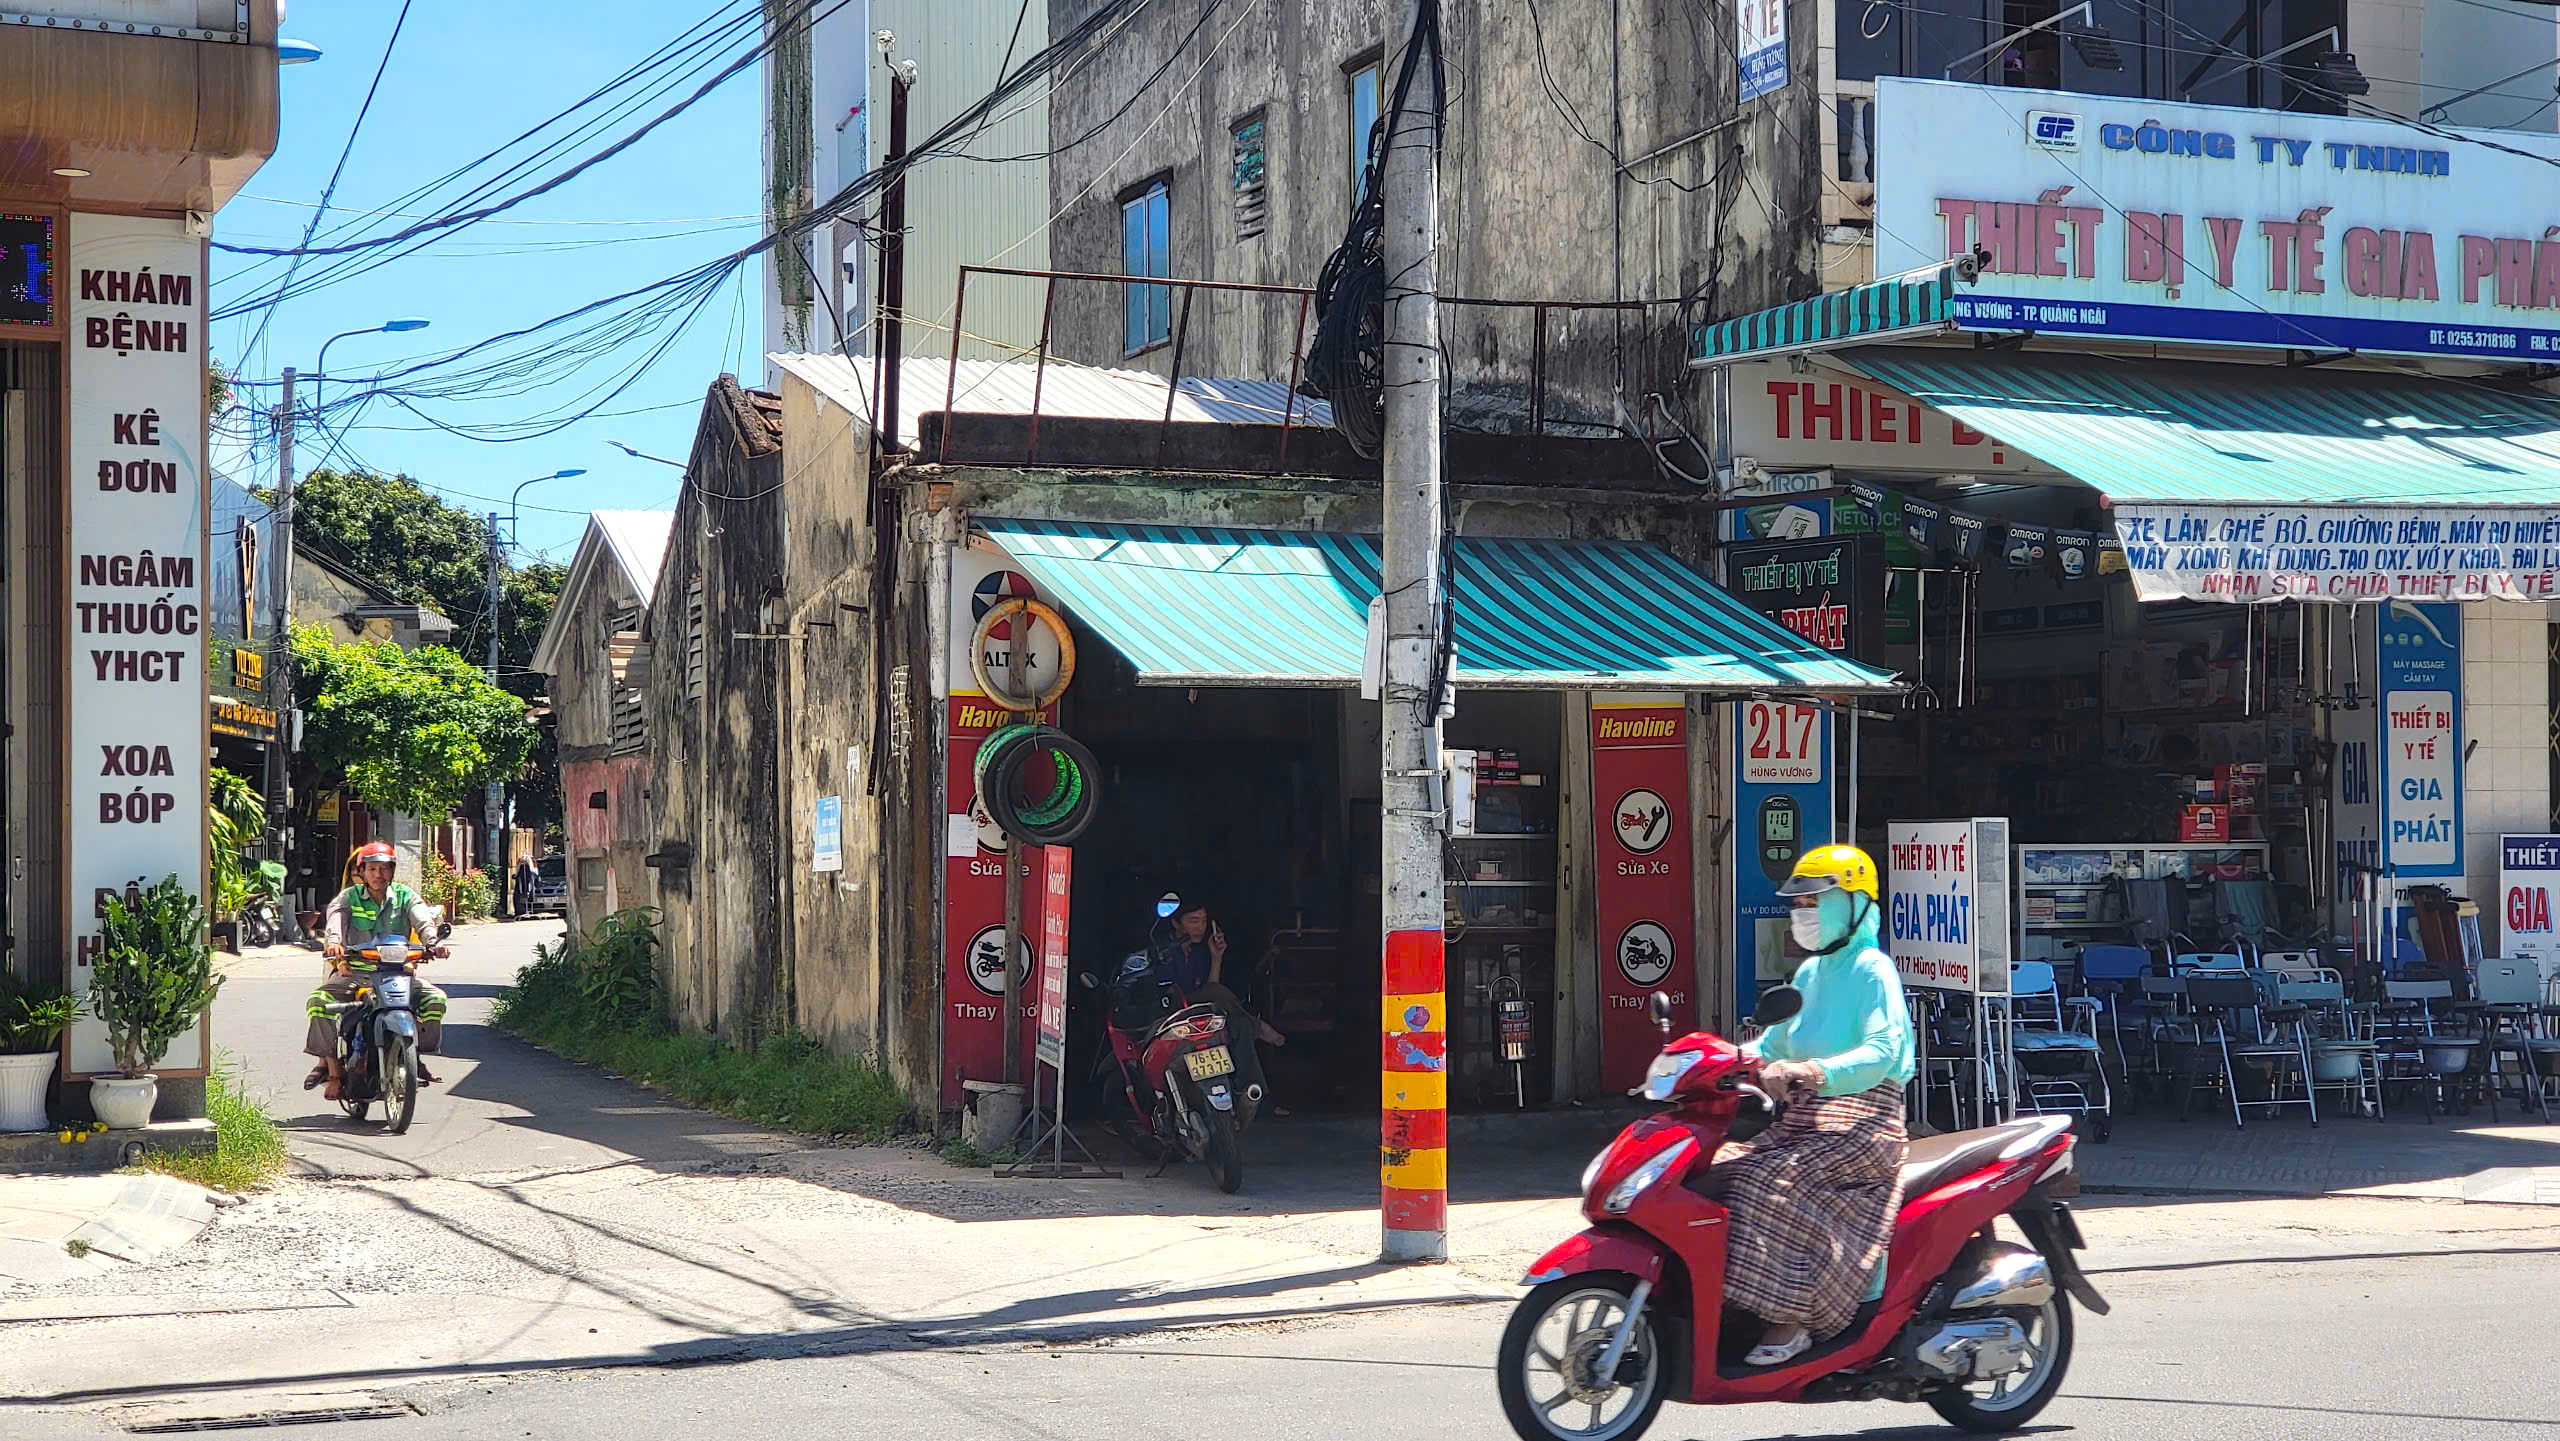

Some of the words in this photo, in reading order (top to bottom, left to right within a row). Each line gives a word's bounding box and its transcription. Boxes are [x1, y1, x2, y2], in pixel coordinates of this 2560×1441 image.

[2101, 119, 2236, 160] CÔNG
[2251, 135, 2311, 166] TY
[2324, 142, 2449, 176] TNHH
[1936, 186, 2103, 279] THIẾT
[2124, 210, 2184, 299] BỊ
[2203, 217, 2243, 288] Y
[2259, 206, 2334, 295] TẾ
[2343, 226, 2440, 301] GIA
[81, 267, 192, 306] KHÁM
[1975, 301, 2012, 319] VƯƠNG
[2040, 303, 2077, 324] QUẢNG
[86, 312, 188, 357] BỆNH
[2447, 331, 2517, 349] 0255.3718186
[2531, 336, 2550, 350] FAX:
[113, 408, 161, 446] KÊ
[98, 459, 177, 494] ĐƠN
[1850, 484, 1883, 502] OMRON
[1904, 503, 1938, 520] OMRON
[1950, 515, 1983, 530] OMRON
[2010, 528, 2045, 542] OMRON
[2056, 535, 2090, 547] OMRON
[2098, 538, 2123, 548] OMR
[2128, 517, 2155, 542] XE
[2319, 514, 2393, 545] GIƯỜNG
[80, 549, 194, 588] NGÂM
[2128, 543, 2171, 569] MÁY
[2237, 543, 2275, 570] KHÍ
[1743, 555, 1784, 592] THIẾT
[1786, 562, 1802, 595] BỊ
[1804, 560, 1817, 586] Y
[1818, 548, 1841, 585] TẾ
[2271, 570, 2319, 596] SỬA
[2329, 571, 2389, 596] CHỮA
[2398, 569, 2456, 596] THIẾT
[2497, 574, 2513, 594] Y
[2523, 568, 2559, 594] TẾ
[76, 592, 198, 635] THUỐC
[90, 650, 185, 682] YHCT
[2393, 659, 2410, 669] MÁY
[2412, 661, 2446, 669] MASSAGE
[2422, 674, 2436, 683] TAY
[958, 706, 1048, 728] Havone
[1600, 716, 1676, 738] Havoline
[2391, 704, 2431, 728] THIẾT
[2436, 711, 2450, 734] BỊ
[1750, 703, 1815, 760] 217
[100, 745, 175, 777] XOA
[2404, 743, 2414, 760] Y
[2419, 735, 2438, 760] TẾ
[1751, 765, 1777, 777] HÙNG
[1779, 766, 1813, 778] VƯƠNG
[2343, 742, 2370, 805] GIA
[2401, 778, 2443, 801] GIA
[100, 785, 175, 824] BÓP
[2393, 813, 2452, 843] PHÁT
[970, 858, 1003, 876] Sửa
[1892, 832, 1922, 871] THIẾT
[1926, 844, 1937, 879] BỊ
[1941, 845, 1949, 872] Y
[1951, 832, 1967, 872] TẾ
[2506, 841, 2559, 866] THIẾT
[1617, 860, 1646, 875] Sửa
[1650, 861, 1669, 874] Xe
[1892, 891, 1922, 941] GIA
[1926, 879, 1969, 944] PHÁT
[2507, 886, 2553, 934] GIA
[1913, 955, 1936, 981] Hùng
[1939, 958, 1969, 984] Vương
[954, 1003, 997, 1021] Thay
[1609, 995, 1645, 1010] Thay
[1192, 1048, 1223, 1065] 76-E1
[1192, 1060, 1231, 1078] 373.75
